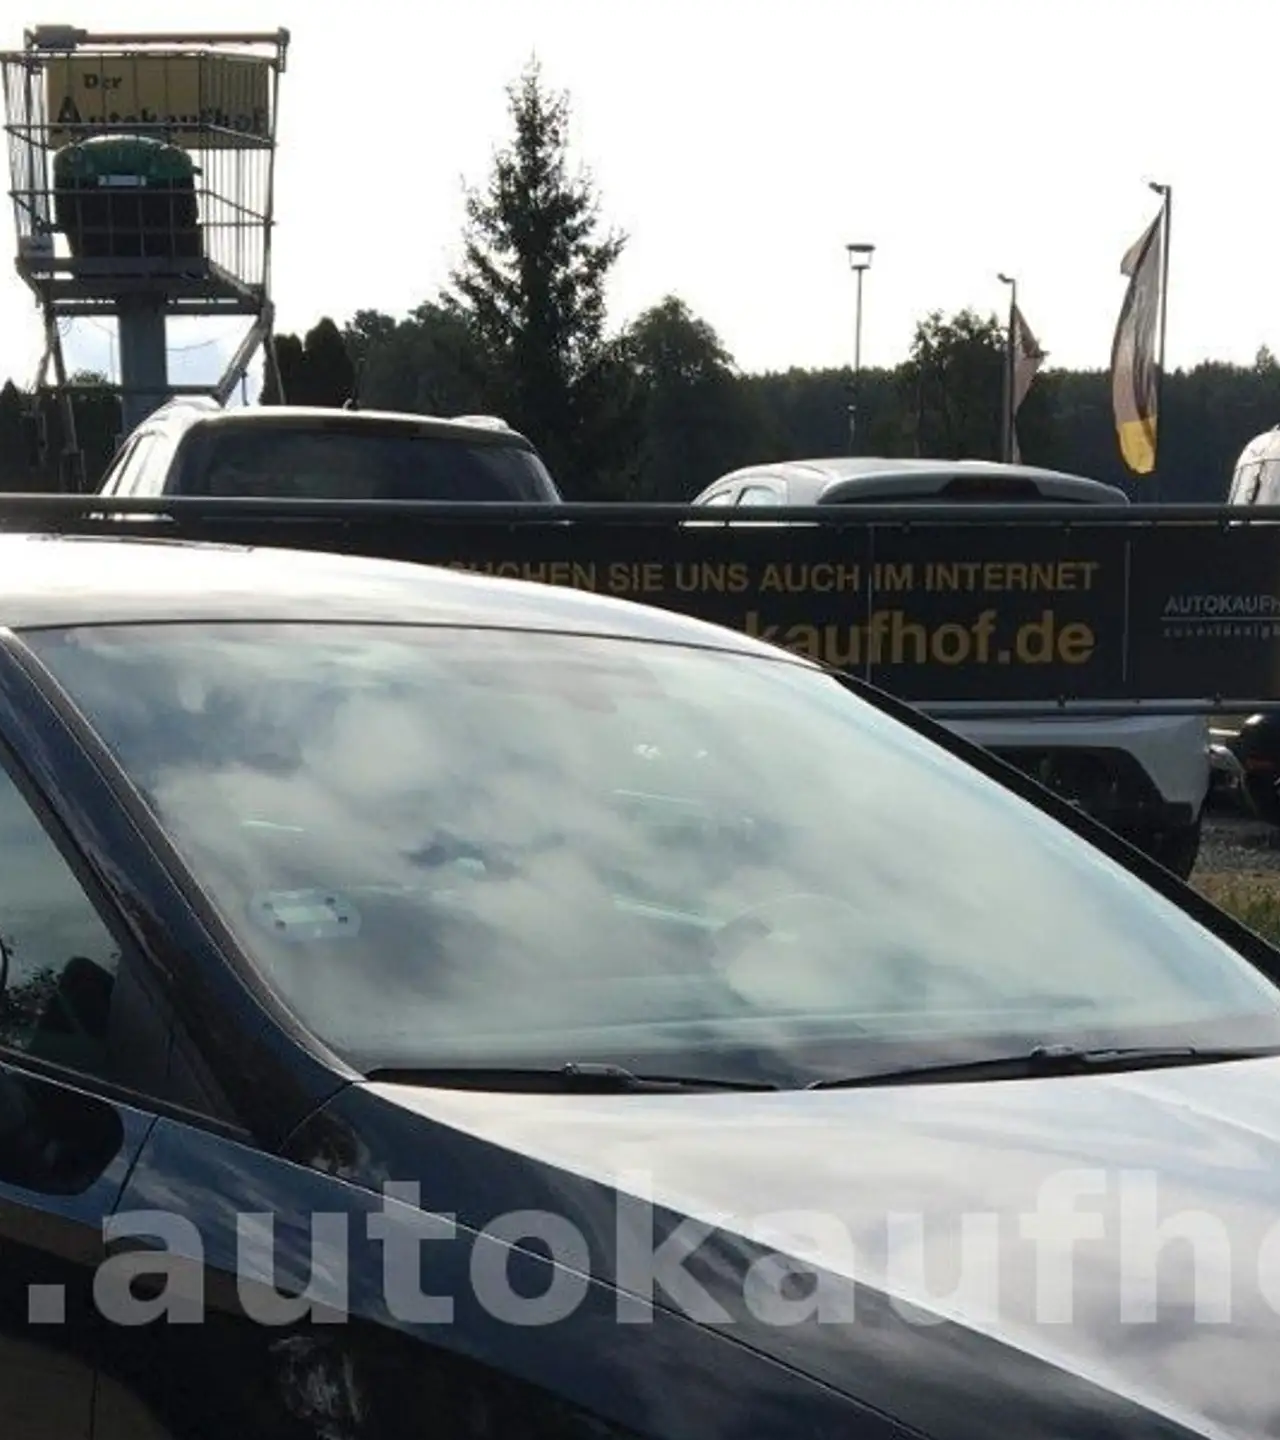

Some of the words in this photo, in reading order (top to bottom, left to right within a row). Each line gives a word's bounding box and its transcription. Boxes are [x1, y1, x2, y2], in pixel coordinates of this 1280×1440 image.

[446, 560, 596, 592] CHEN
[608, 563, 663, 592] SIE
[675, 562, 750, 592] UNS
[759, 562, 861, 592] AUCH
[874, 562, 913, 592] IM
[925, 561, 1100, 592] INTERNET
